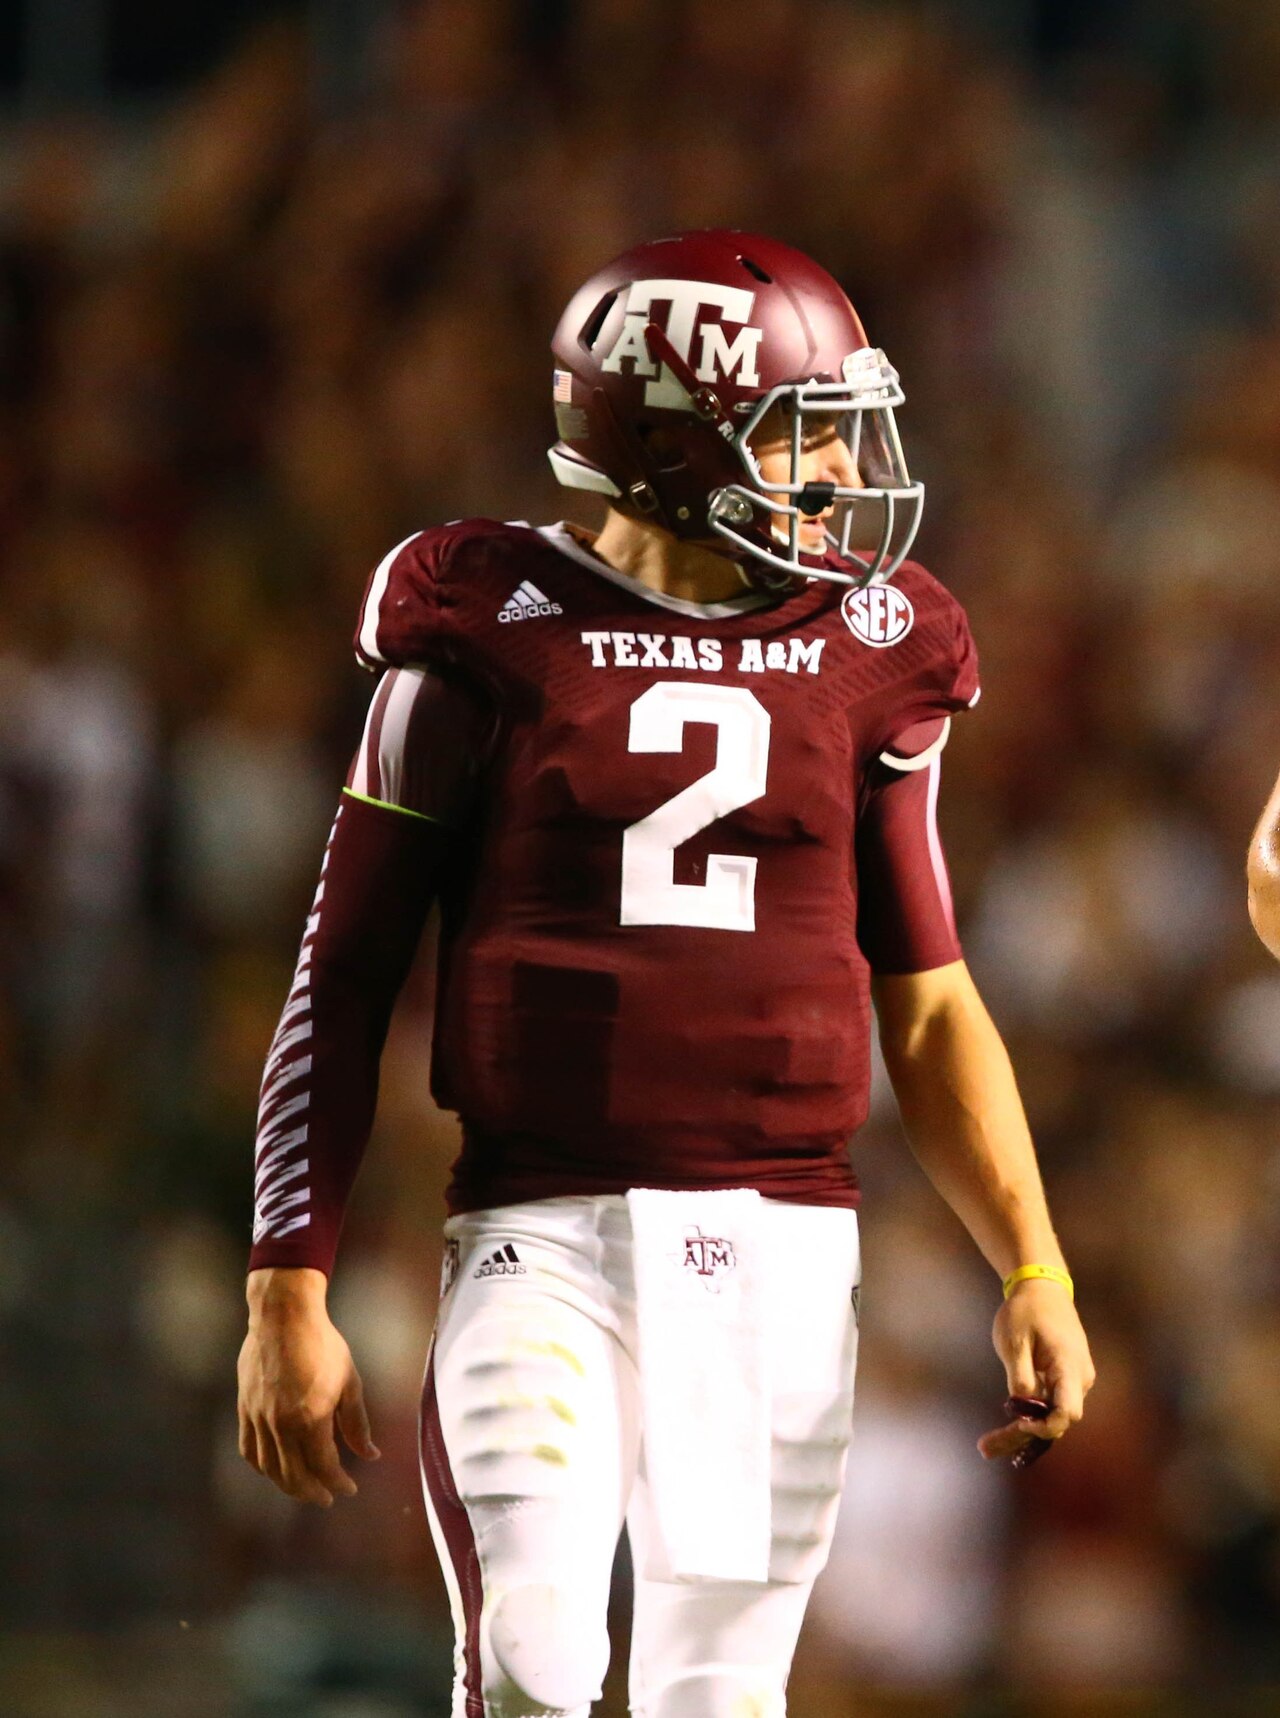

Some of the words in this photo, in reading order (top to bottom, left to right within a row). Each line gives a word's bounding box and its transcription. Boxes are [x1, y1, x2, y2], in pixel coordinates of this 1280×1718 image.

[497, 602, 563, 623] adidas
[848, 587, 906, 641] SEC
[582, 631, 724, 672] TEXAS
[737, 638, 826, 675] A&M
[620, 681, 771, 932] 2
[473, 1262, 527, 1279] adidas
